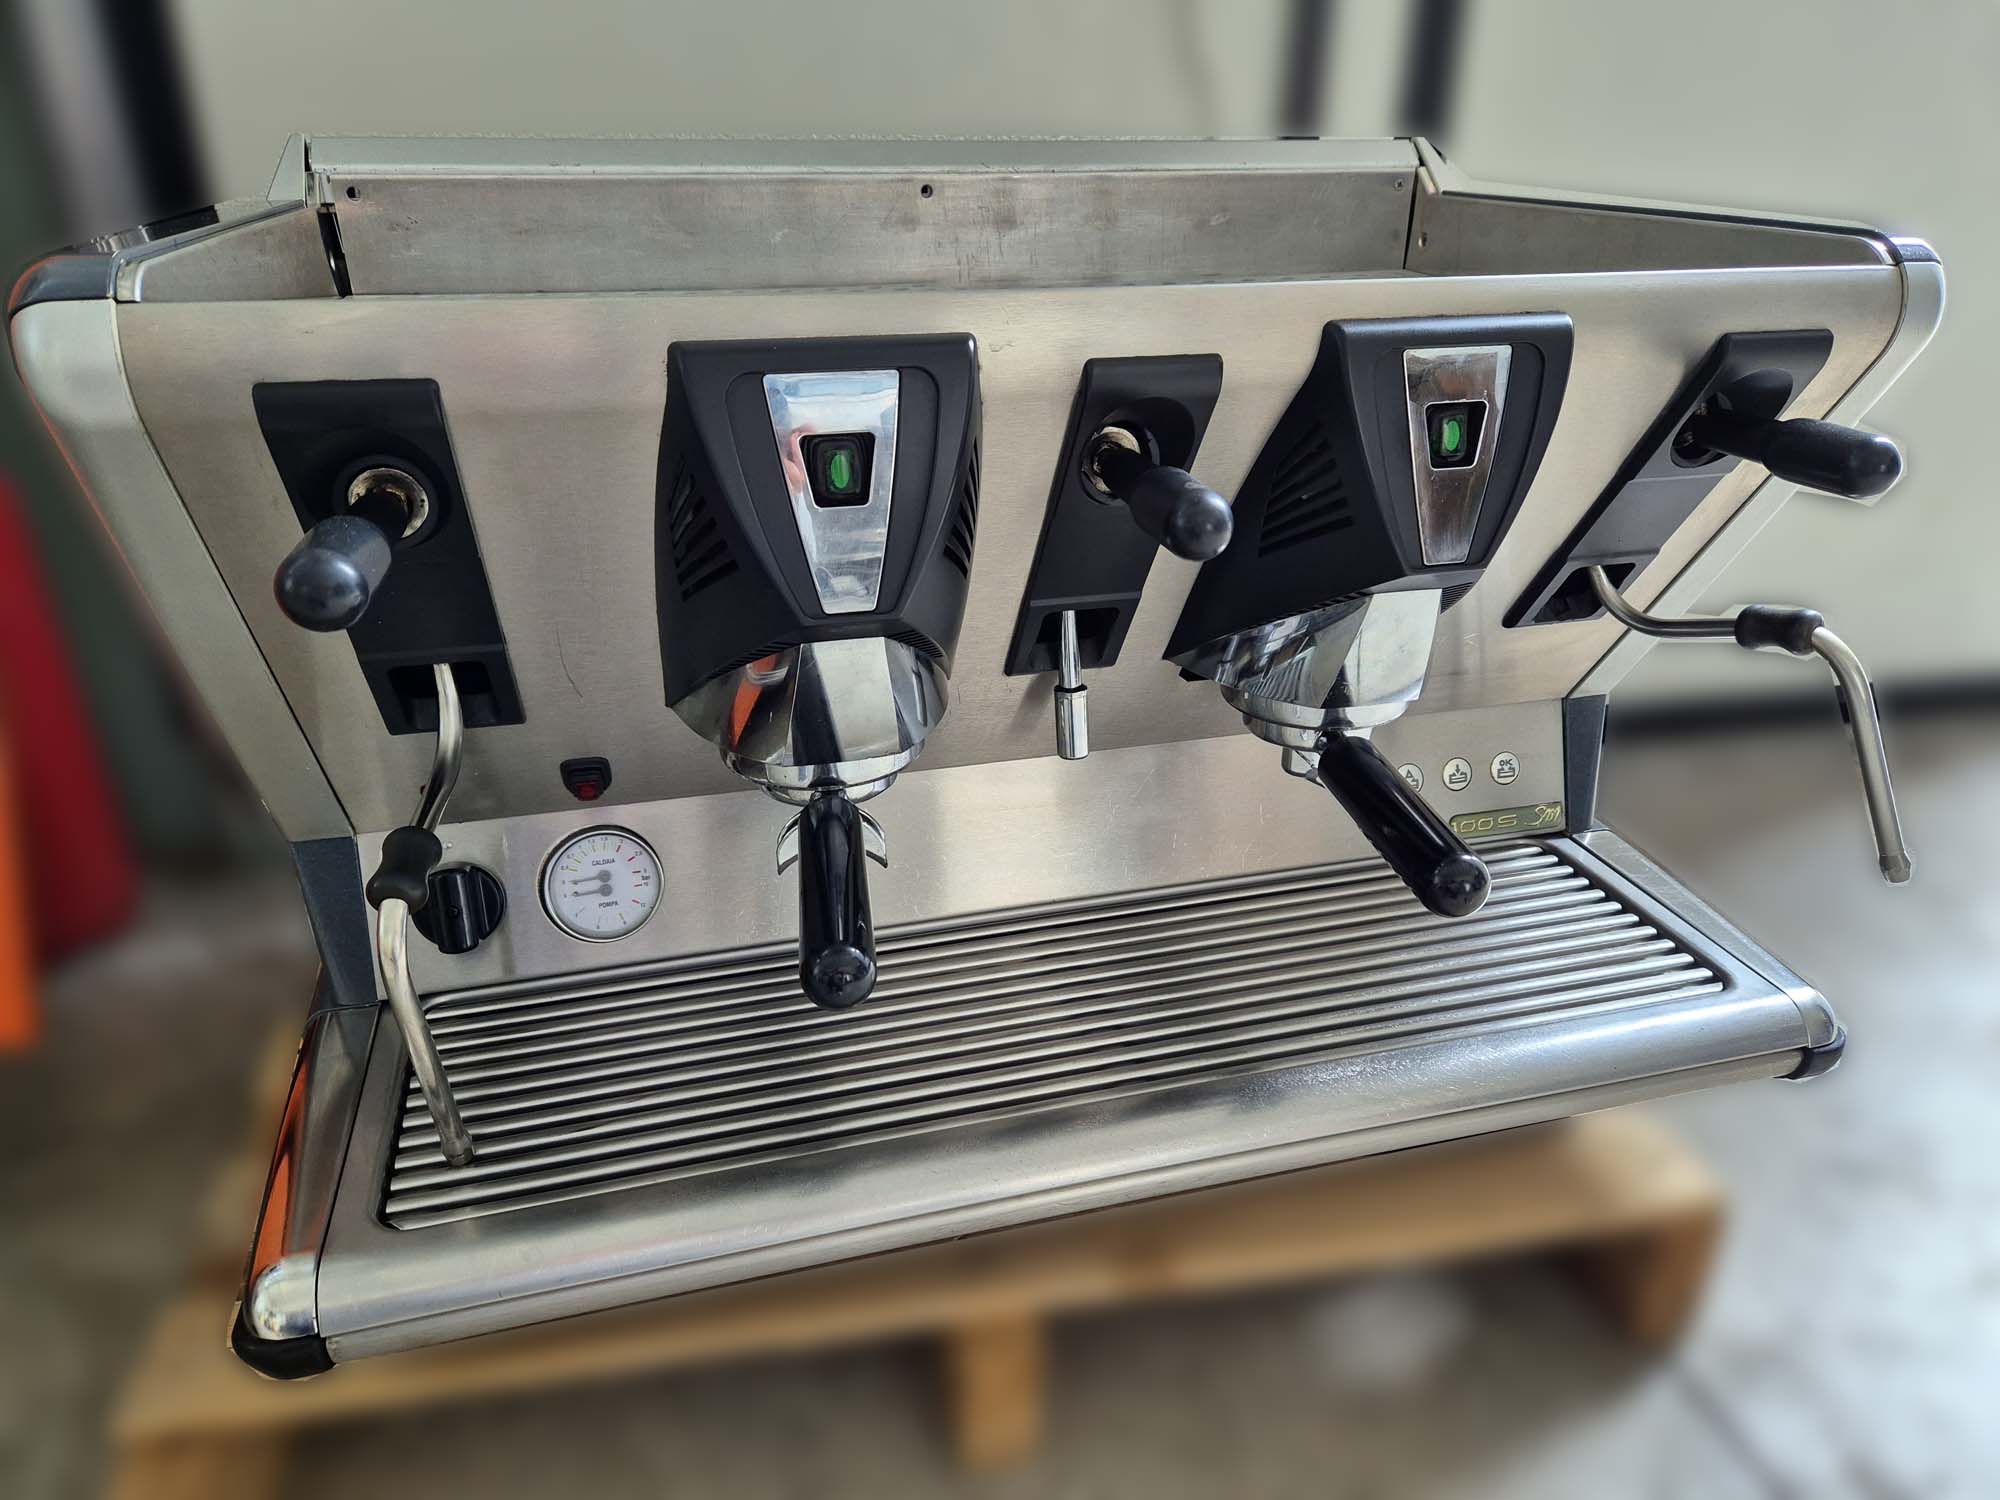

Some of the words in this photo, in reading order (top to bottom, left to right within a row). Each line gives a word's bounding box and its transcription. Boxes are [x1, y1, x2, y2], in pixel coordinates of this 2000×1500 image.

[1498, 758, 1513, 767] OK
[592, 857, 616, 866] CALDAIA
[598, 900, 619, 908] POMPA
